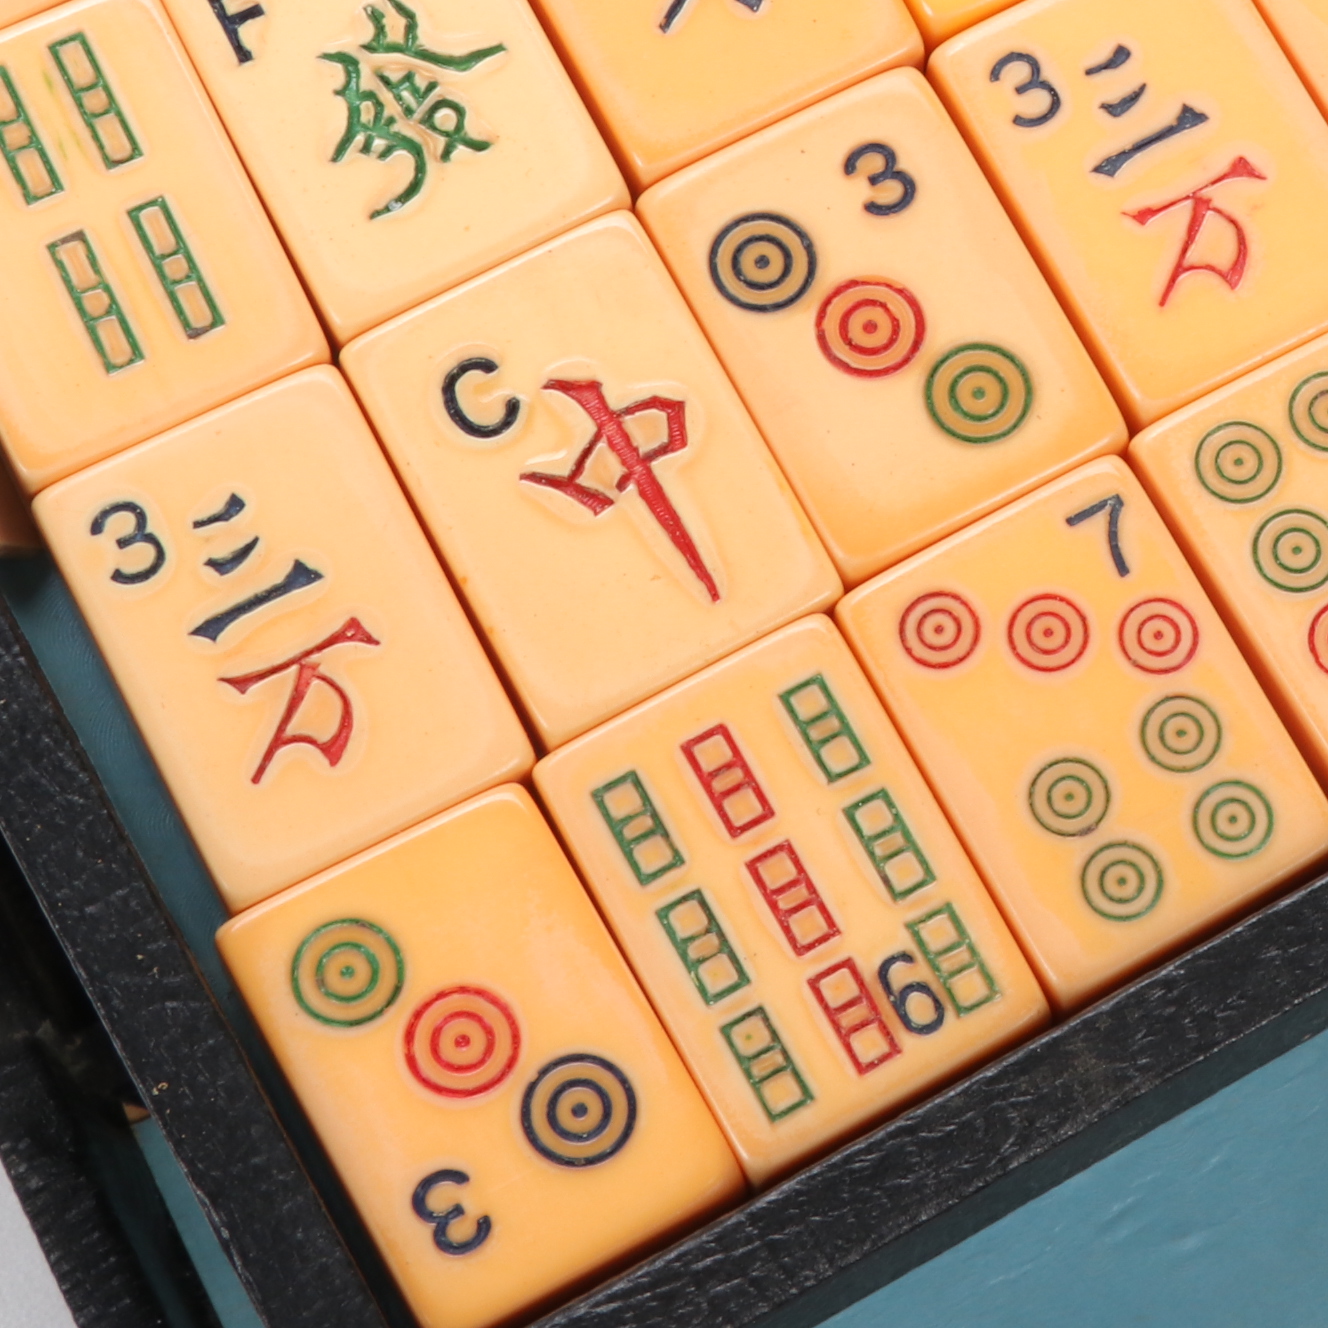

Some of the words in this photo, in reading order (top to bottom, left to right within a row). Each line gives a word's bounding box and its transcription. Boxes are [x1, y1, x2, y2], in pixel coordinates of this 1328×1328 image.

[988, 51, 1062, 129] 3
[842, 141, 918, 218] 3
[440, 356, 521, 439] C
[518, 378, 721, 604] 中
[89, 501, 166, 586] 3
[1064, 493, 1131, 578] 7
[410, 1168, 493, 1256] 3
